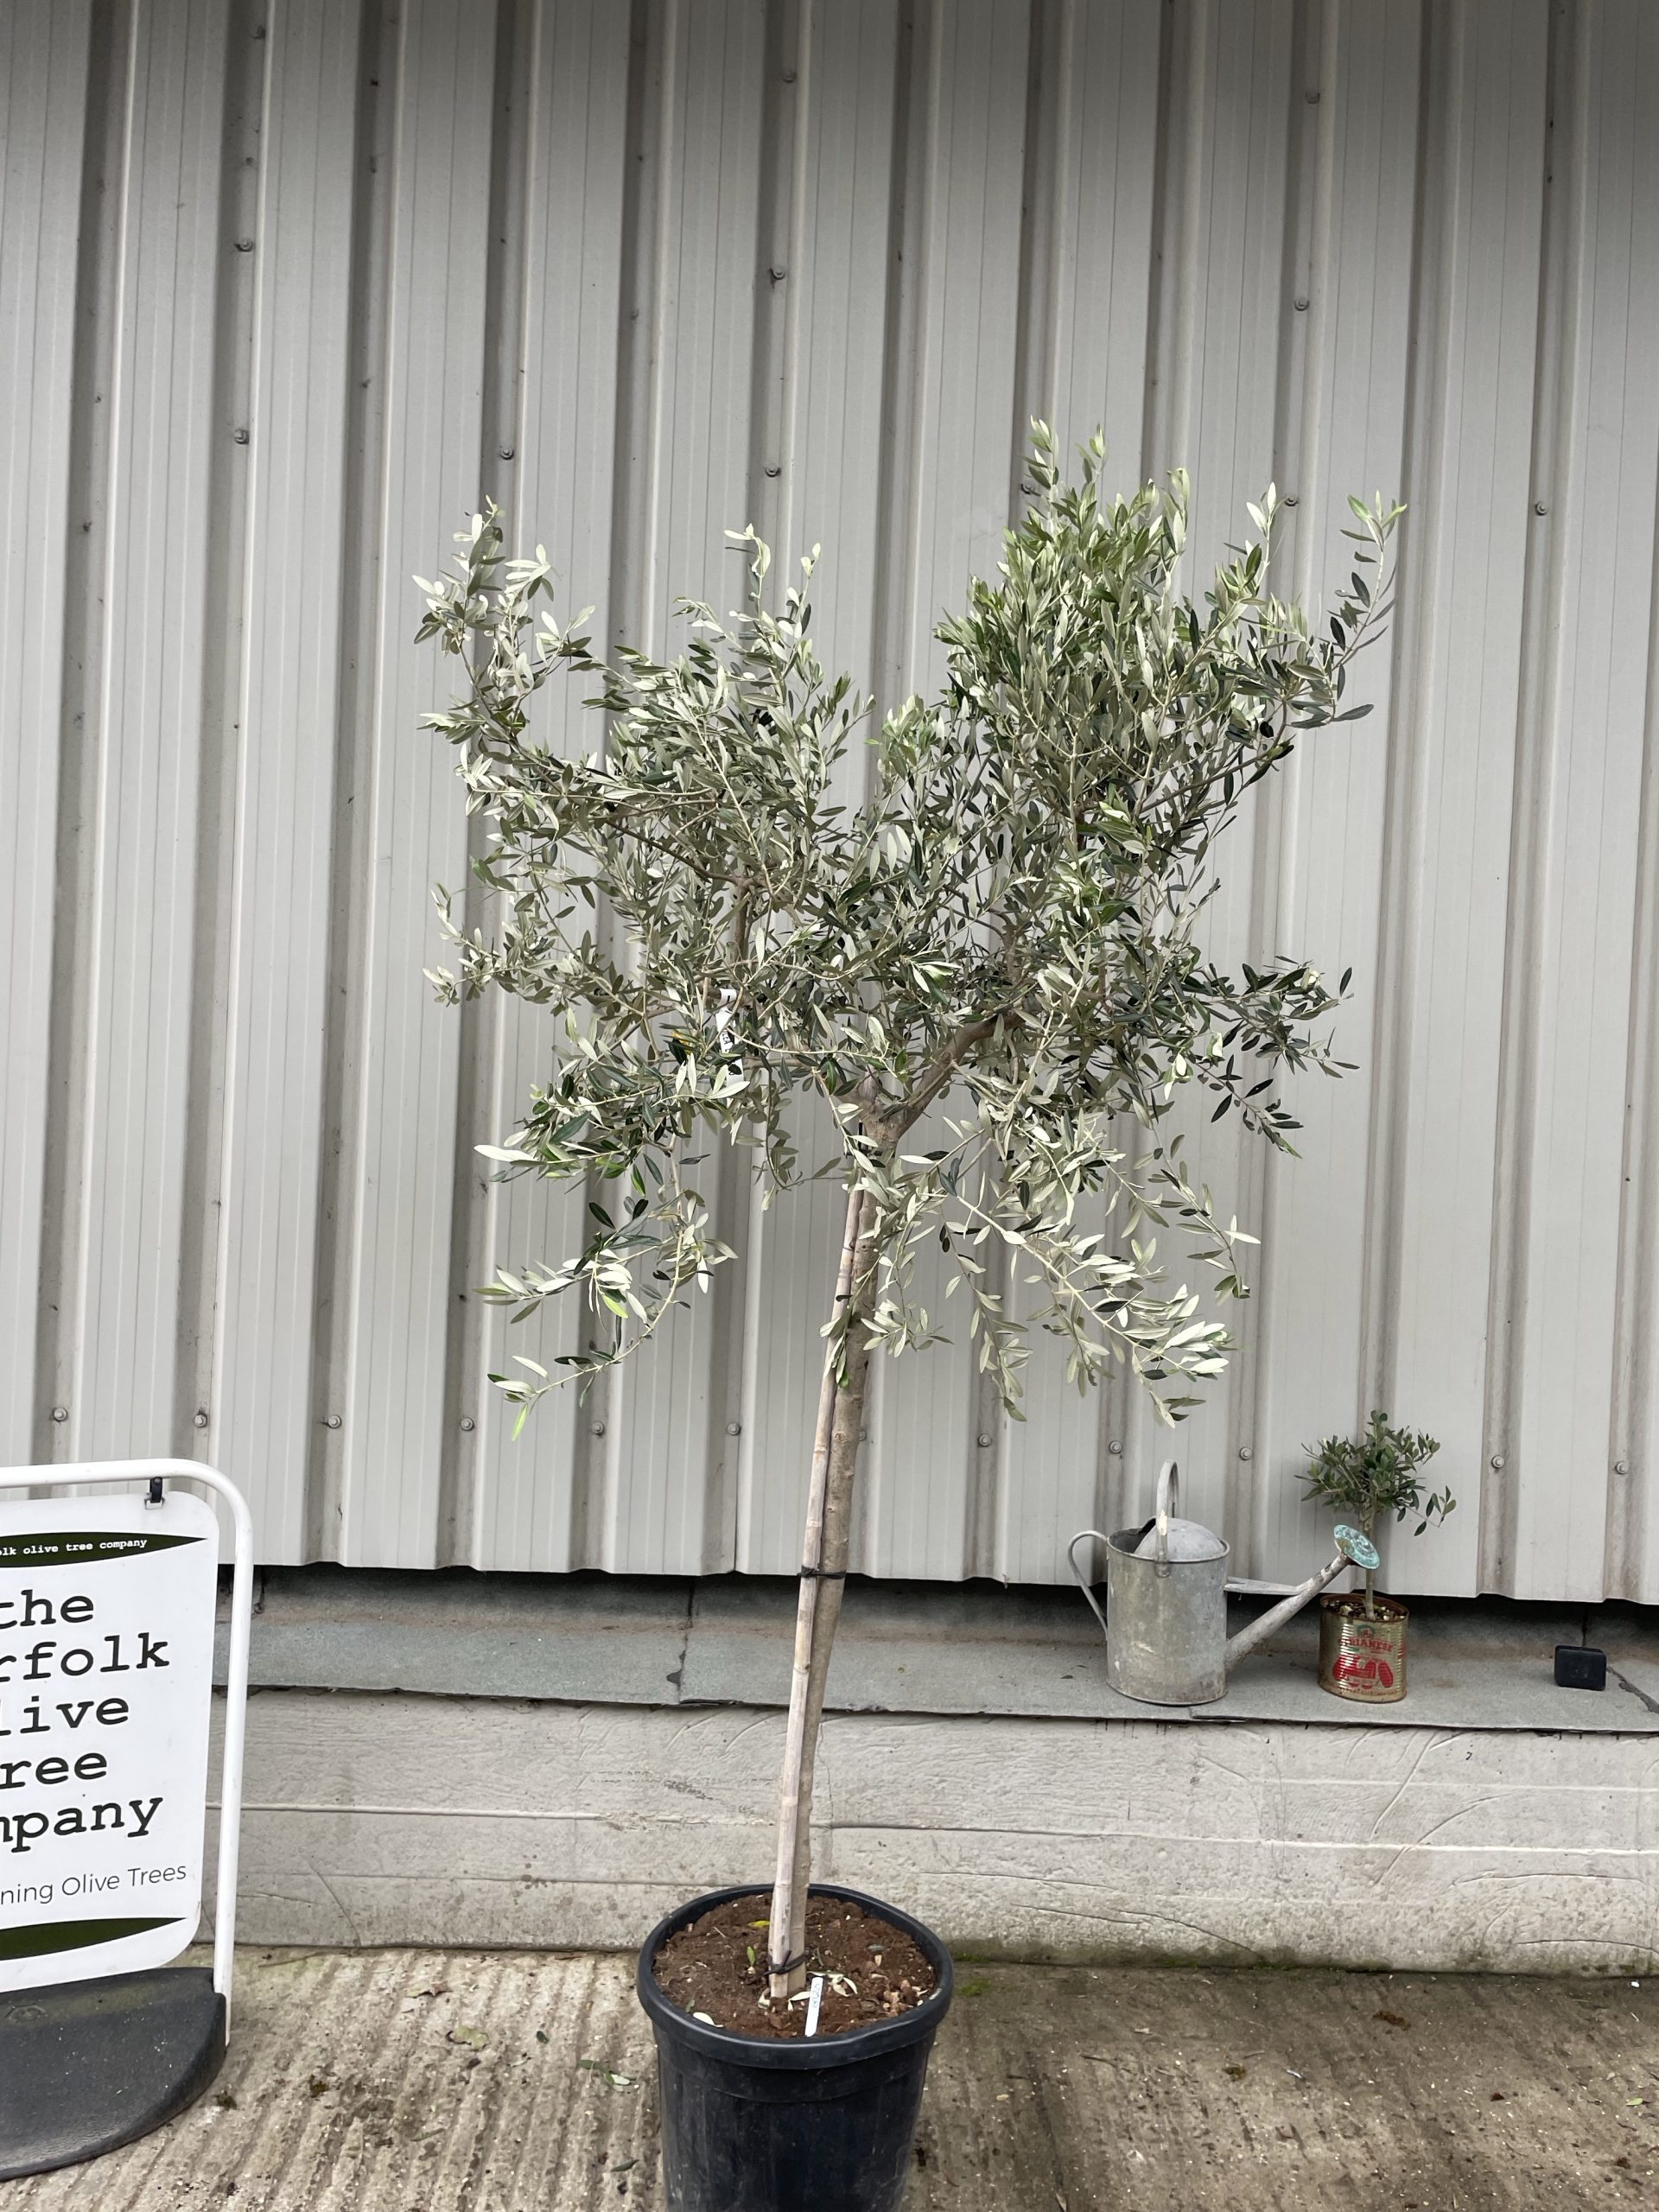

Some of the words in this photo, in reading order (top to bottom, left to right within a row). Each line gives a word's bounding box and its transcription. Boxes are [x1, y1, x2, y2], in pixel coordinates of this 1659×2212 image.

[22, 1544, 59, 1555] olive
[66, 1541, 93, 1552] tree
[99, 1538, 148, 1549] company
[0, 1695, 129, 1737] ive
[0, 1883, 54, 1904] ning
[61, 1873, 120, 1897] Olive
[127, 1865, 187, 1887] Trees
